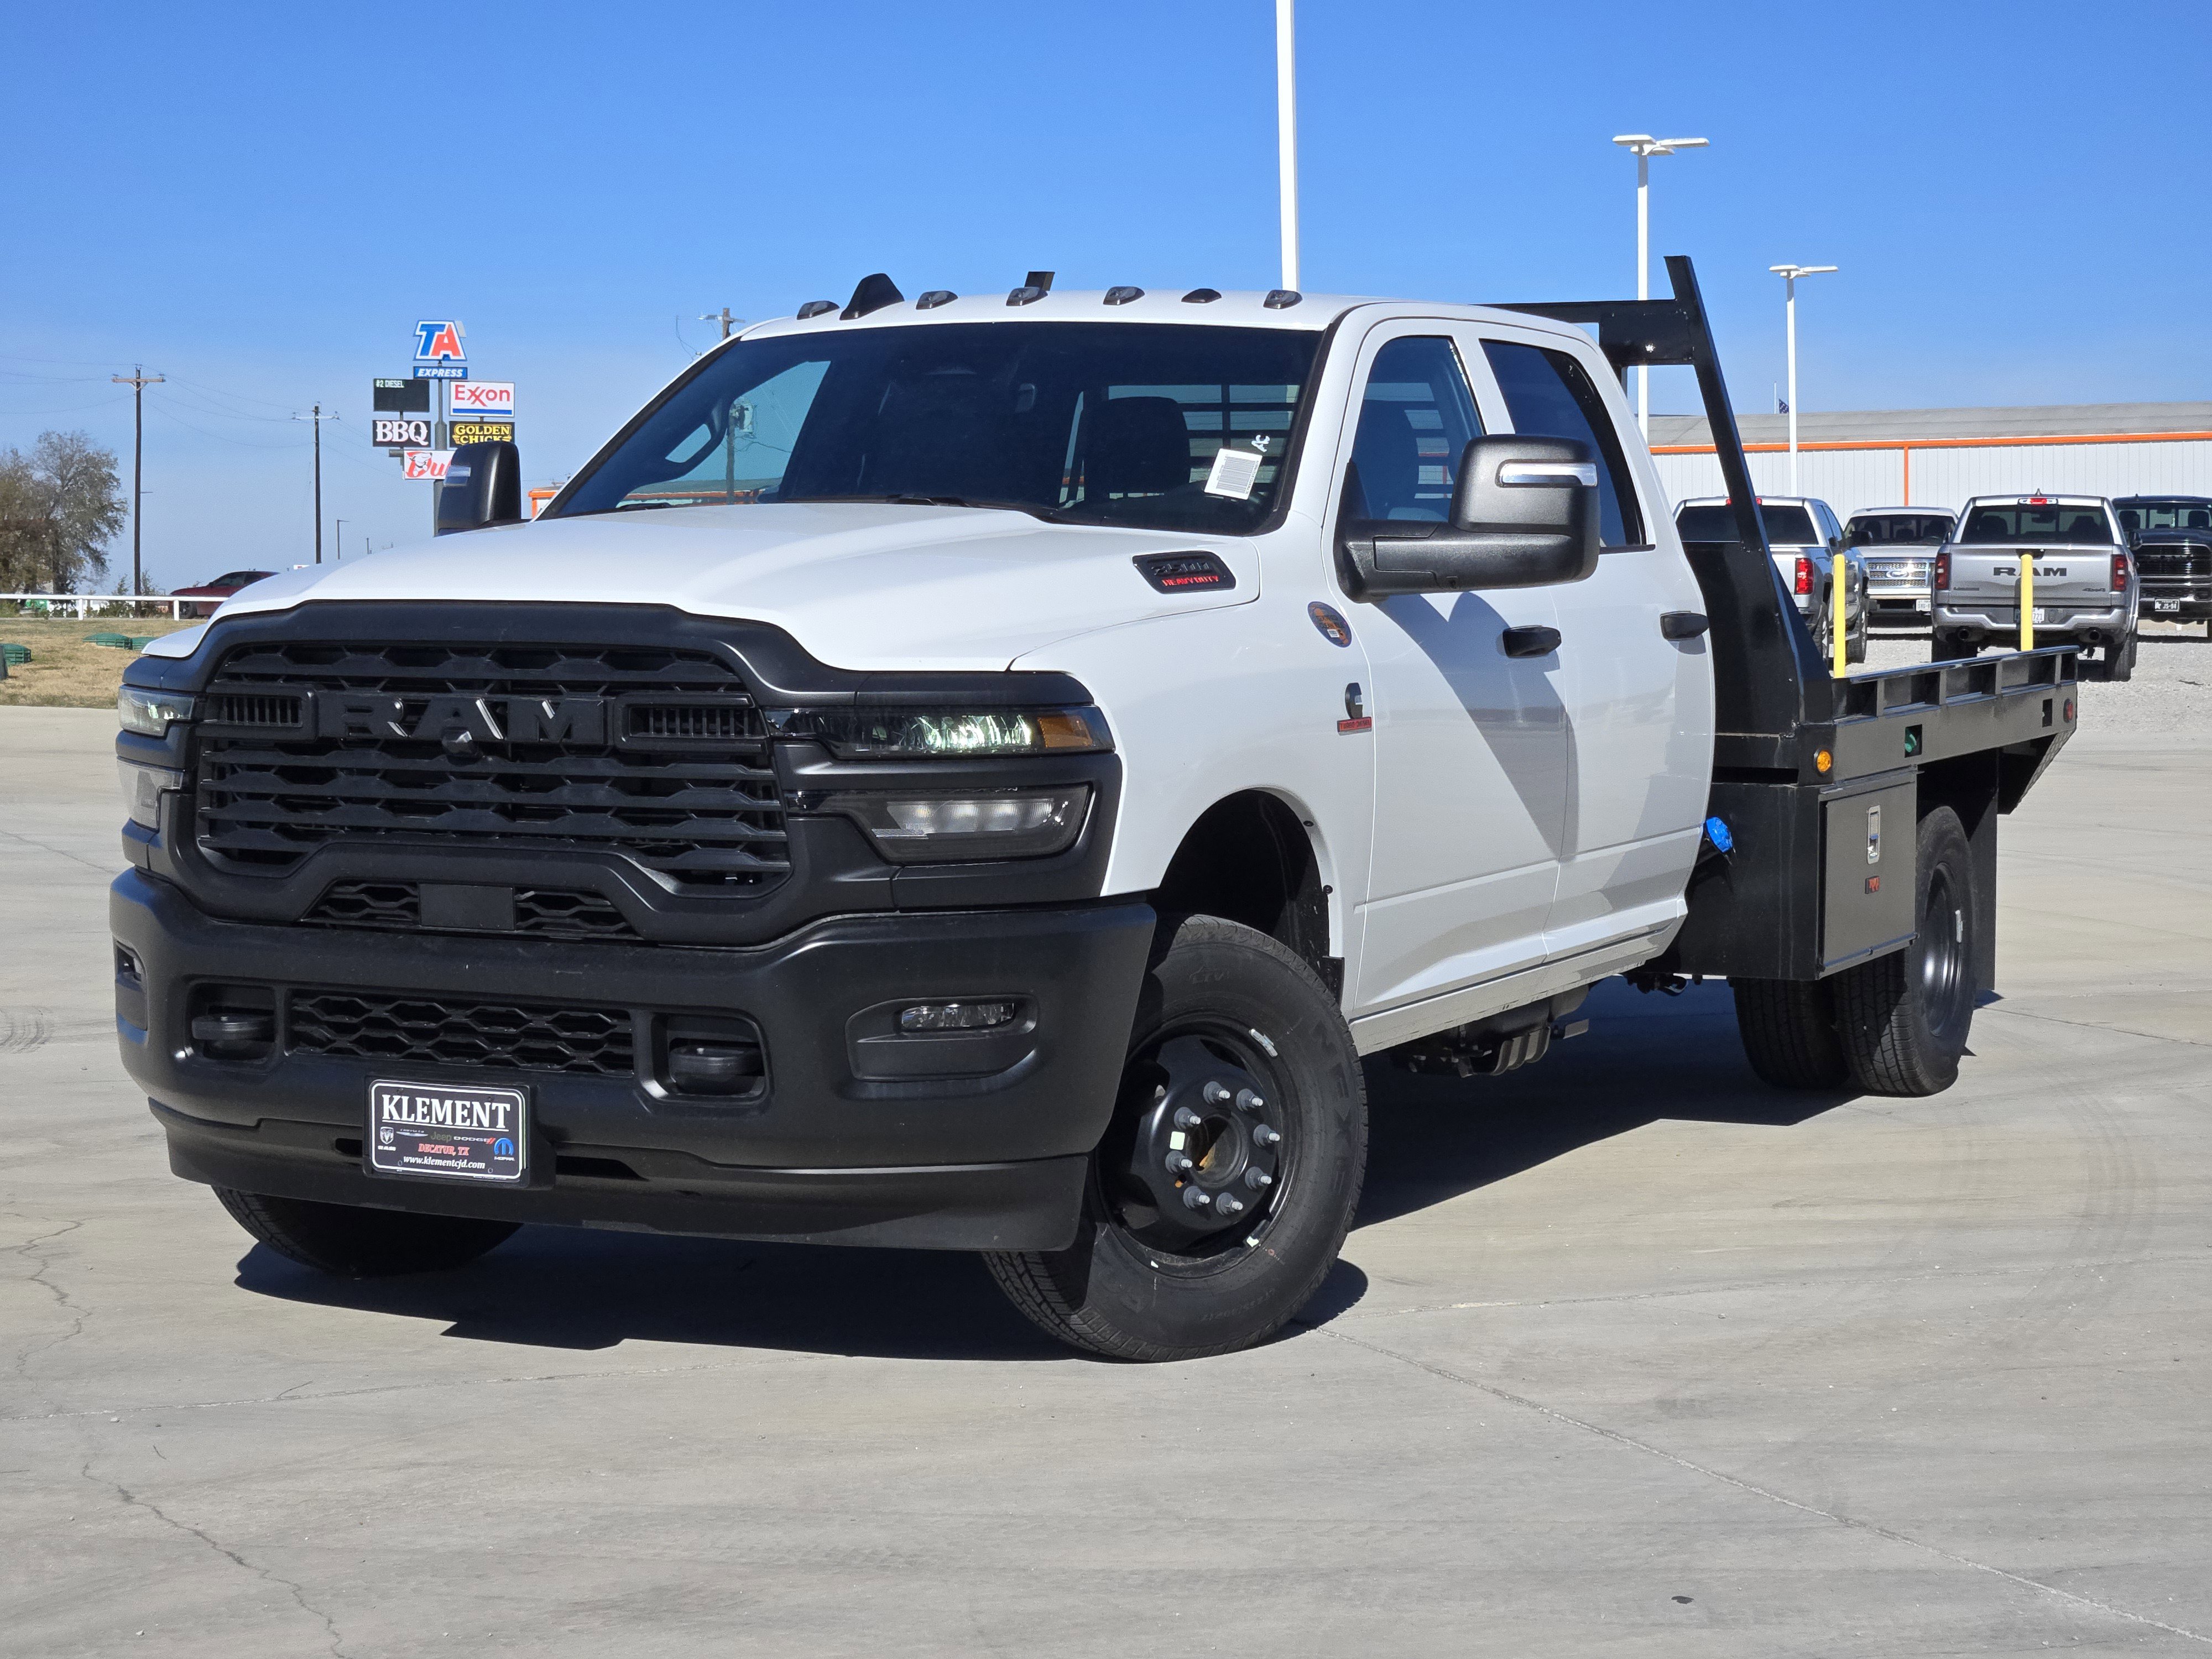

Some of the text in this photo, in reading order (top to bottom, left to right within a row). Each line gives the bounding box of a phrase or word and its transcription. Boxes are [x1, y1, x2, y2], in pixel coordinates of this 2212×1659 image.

[418, 323, 463, 358] TA
[418, 369, 463, 377] EXPRESS
[455, 384, 510, 406] Exxon
[376, 421, 429, 446] BBQ
[455, 425, 510, 435] GOLDEN
[335, 692, 605, 744] RAM
[382, 1094, 510, 1128] KLEMENT
[430, 1132, 452, 1142] Jeep
[418, 1144, 470, 1156] DECATUR, TX
[403, 1155, 486, 1170] www.klementcjd.com
